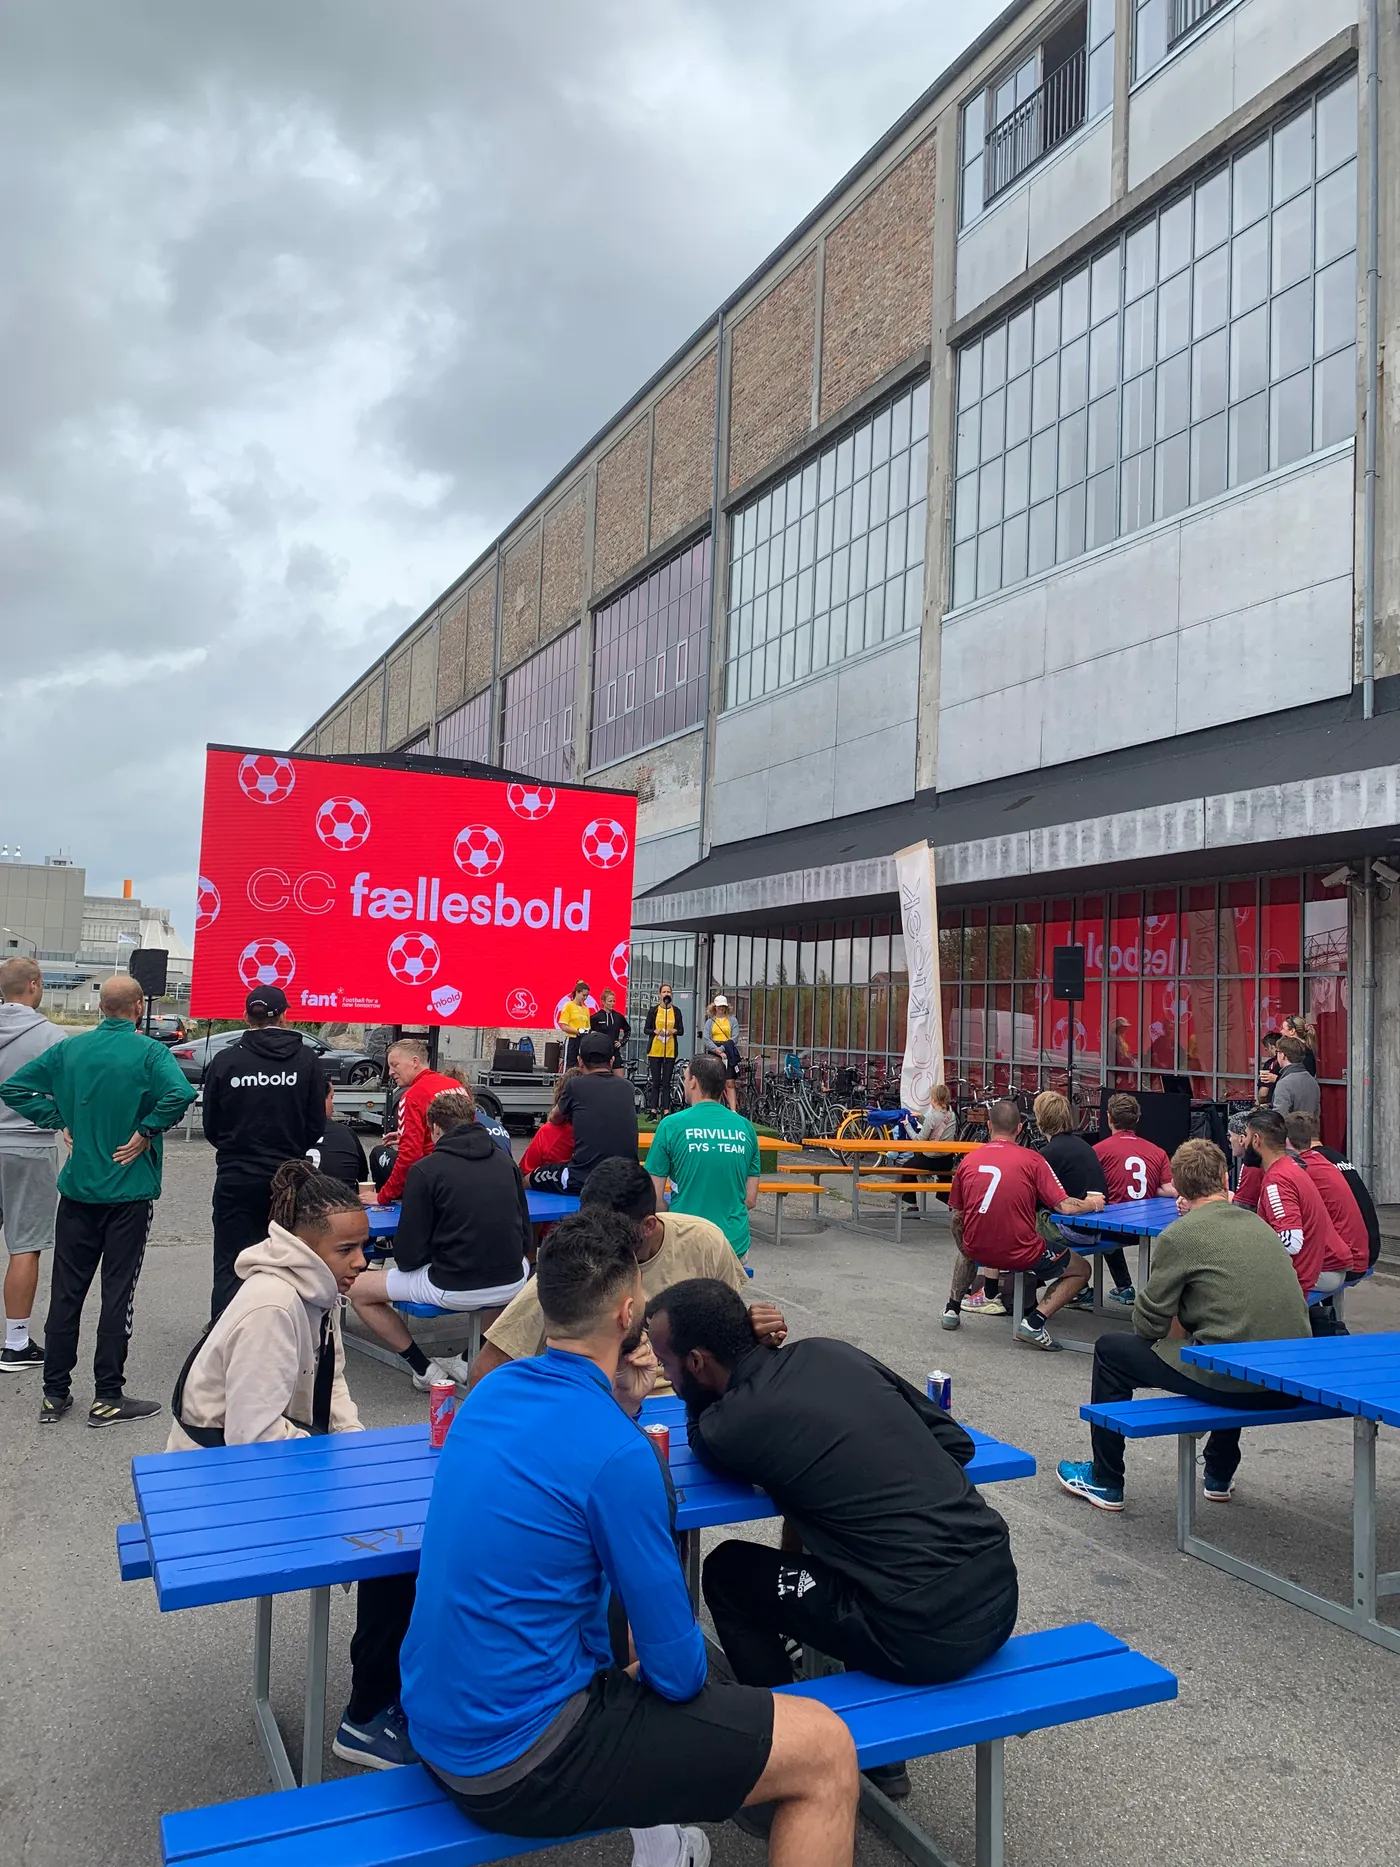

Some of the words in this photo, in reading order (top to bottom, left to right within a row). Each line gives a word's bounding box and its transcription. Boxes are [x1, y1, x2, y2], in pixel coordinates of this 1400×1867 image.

[247, 867, 336, 915] CC
[350, 872, 591, 931] fællesbold
[301, 990, 338, 1007] fant
[685, 1128, 746, 1142] FRIVILLIG
[688, 1143, 709, 1153] FYS
[717, 1143, 745, 1154] TEAM
[978, 1165, 1001, 1214] 7
[1125, 1156, 1148, 1200] 3
[797, 1569, 807, 1598] adidas
